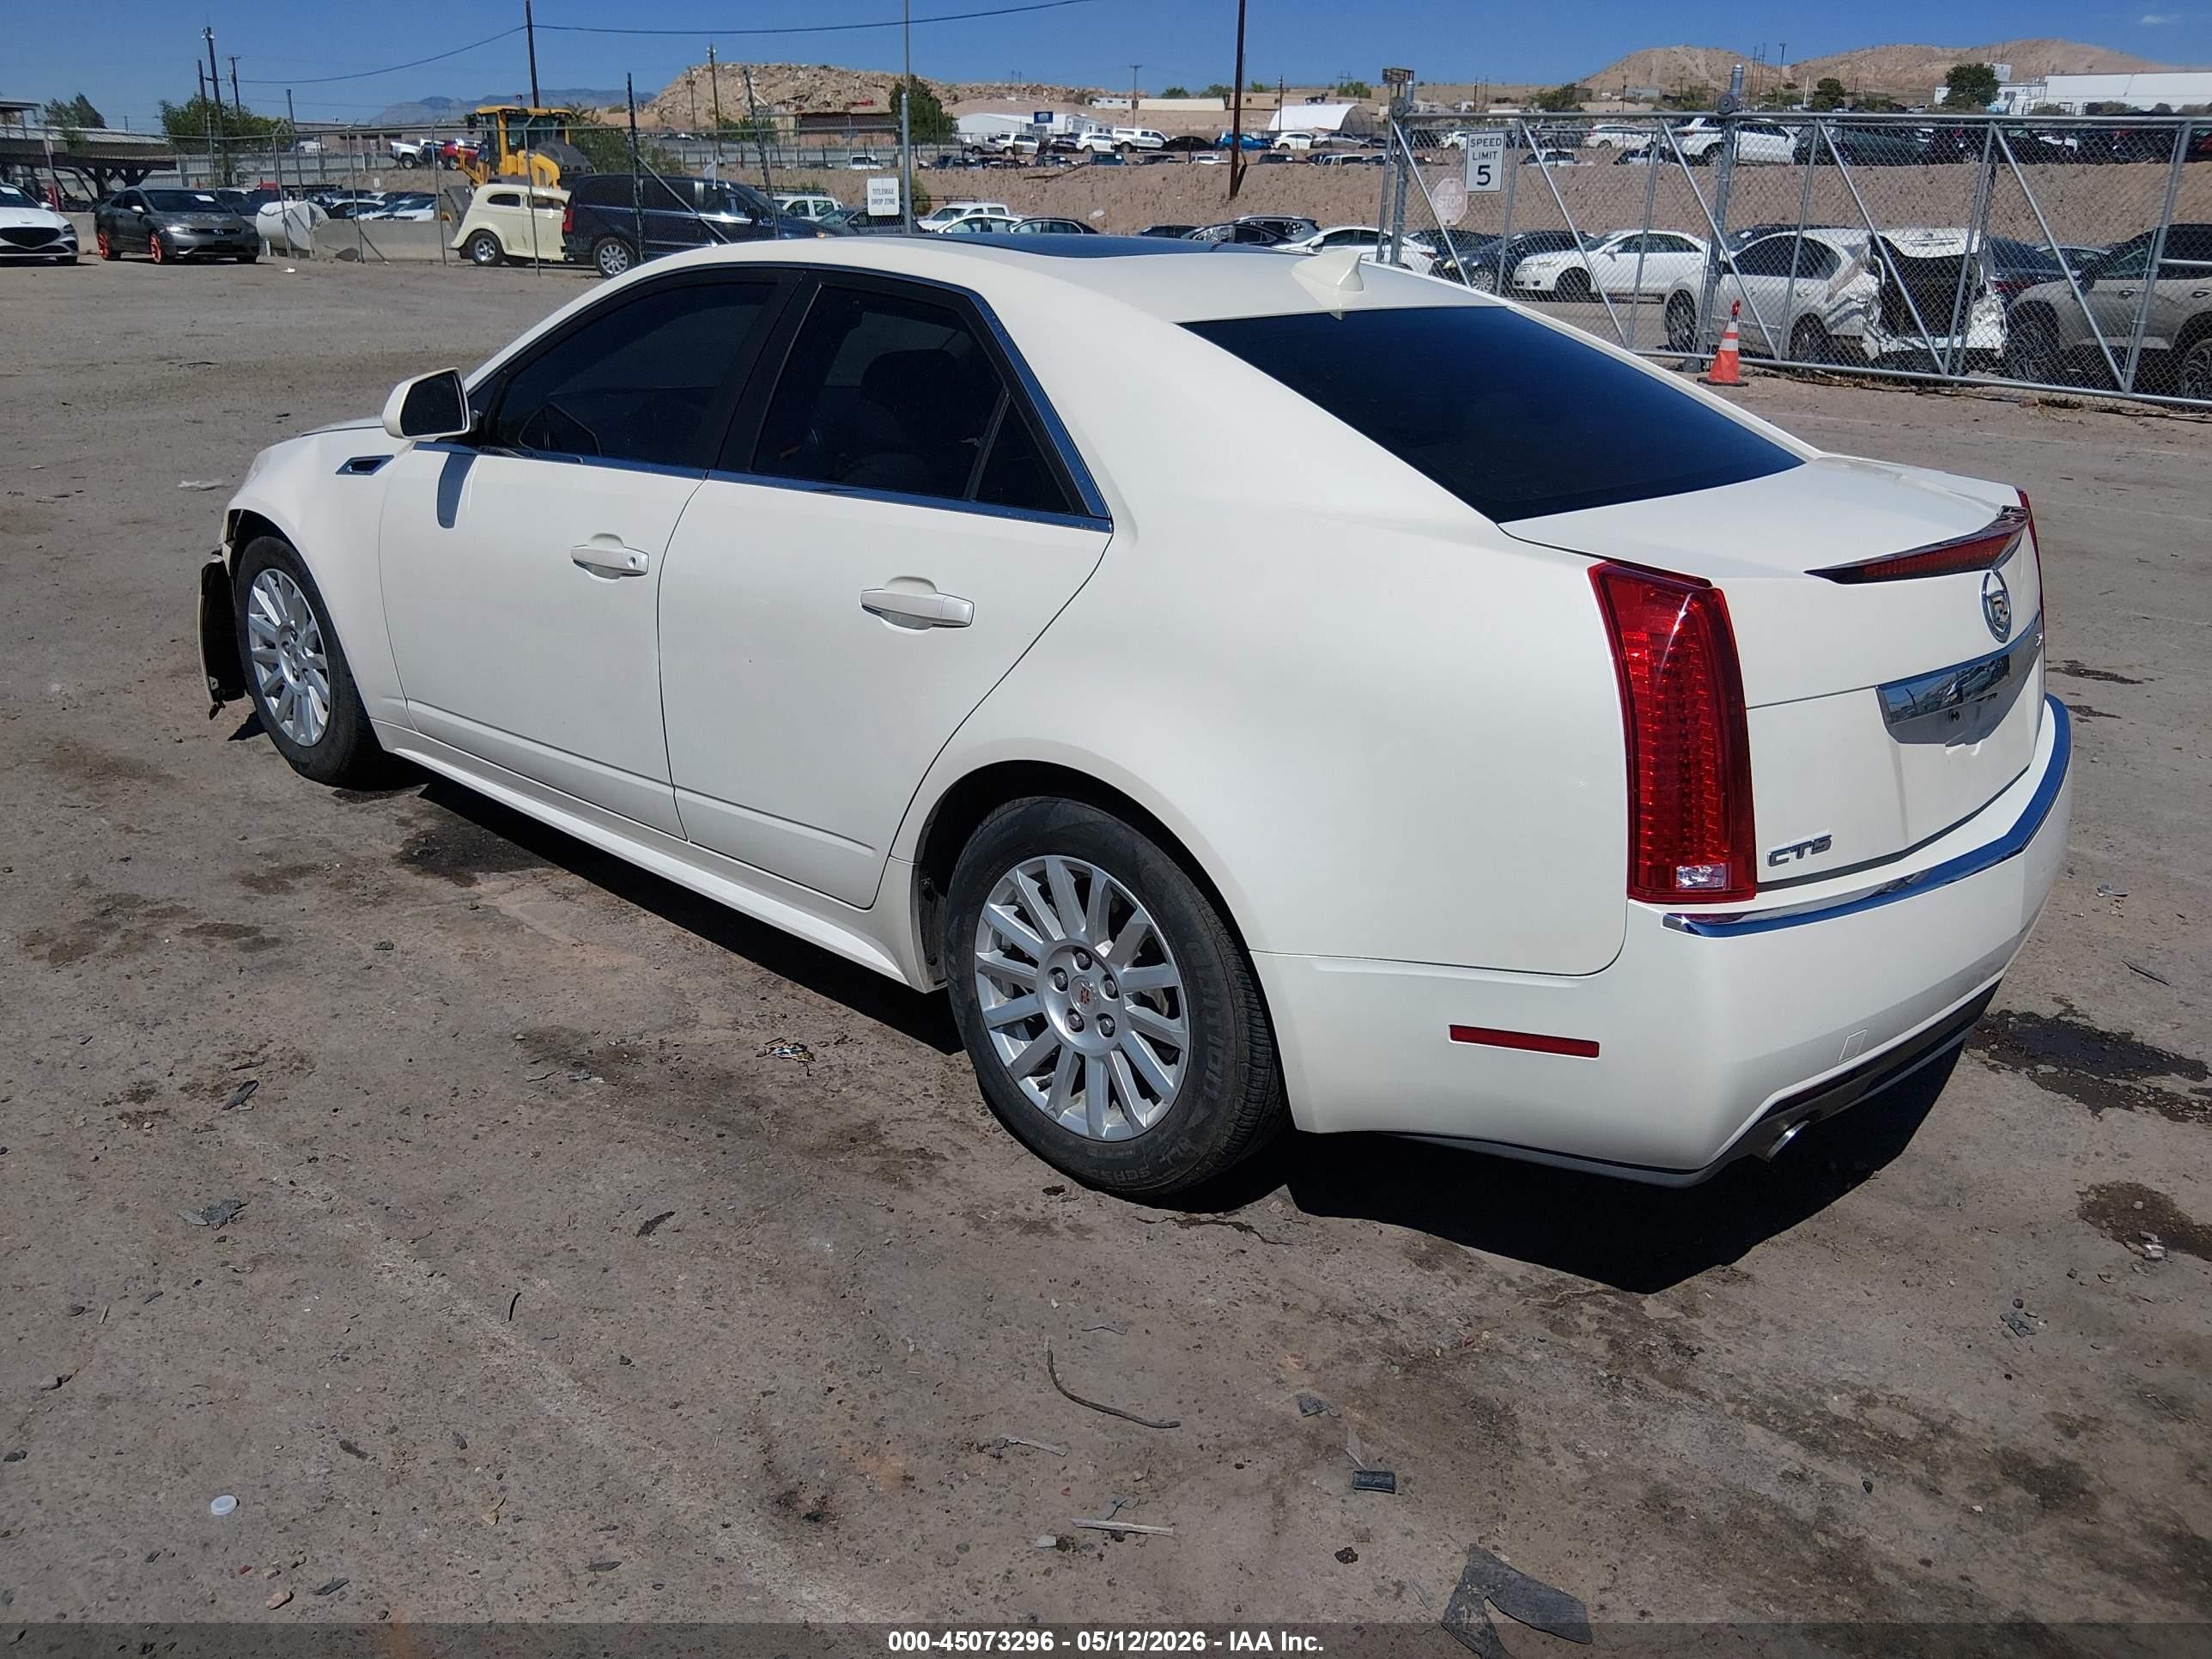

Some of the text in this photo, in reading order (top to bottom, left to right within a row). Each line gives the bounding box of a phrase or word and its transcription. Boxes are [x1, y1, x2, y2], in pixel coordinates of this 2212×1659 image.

[1470, 137, 1502, 148] SPEED
[1472, 150, 1498, 161] LIMIT
[1476, 164, 1491, 185] 5
[871, 198, 884, 206] DROP
[1437, 195, 1462, 208] STOP
[1767, 834, 1832, 868] CTS
